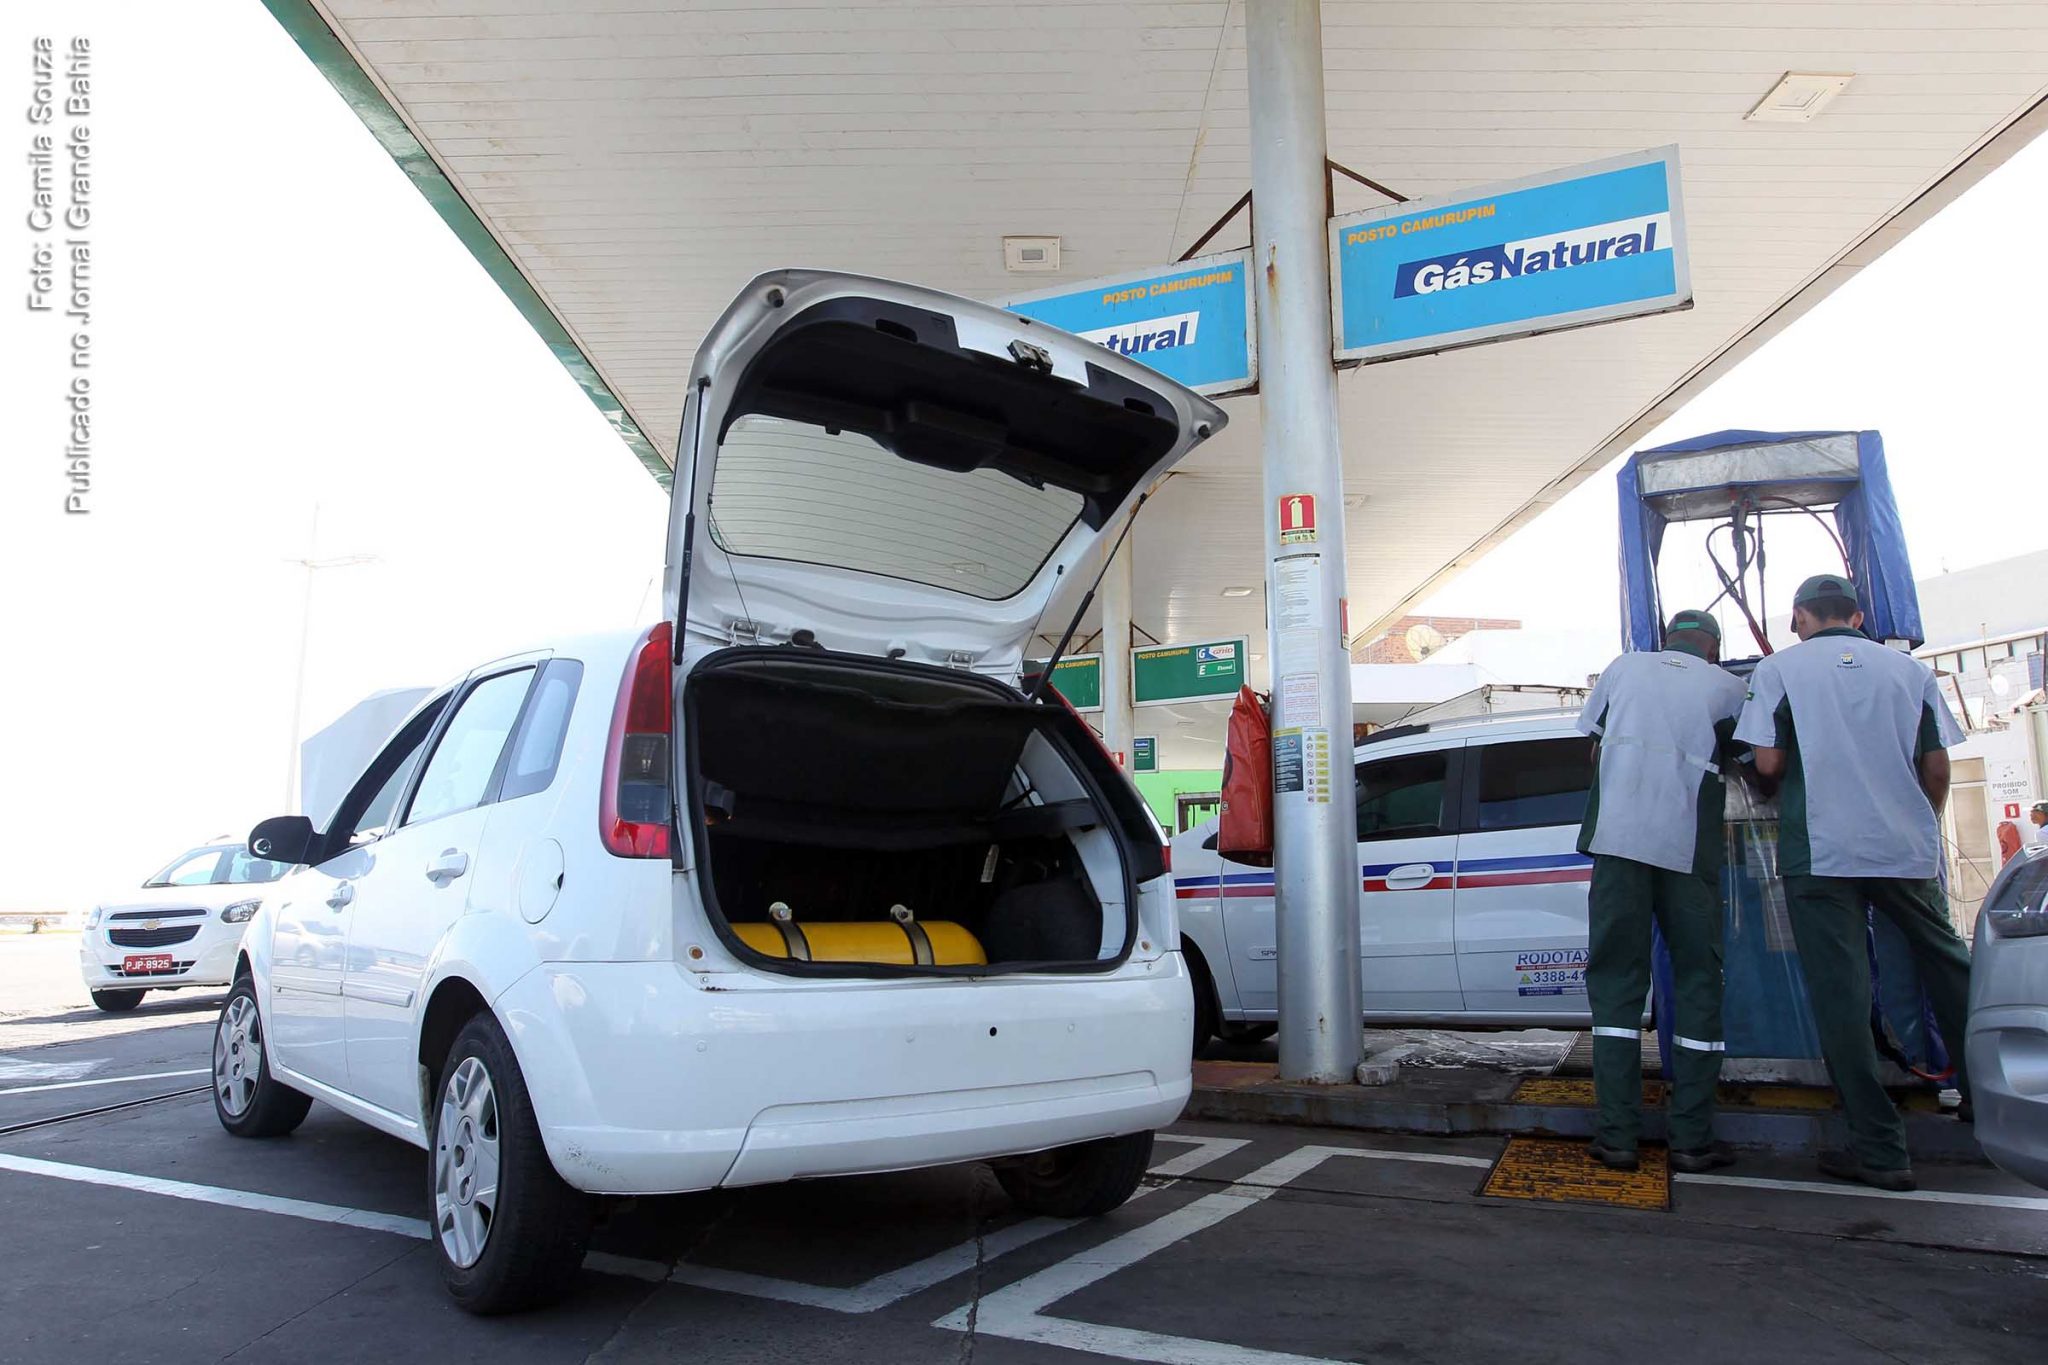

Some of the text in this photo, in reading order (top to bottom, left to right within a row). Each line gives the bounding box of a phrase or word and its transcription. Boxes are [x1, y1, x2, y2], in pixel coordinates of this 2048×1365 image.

[1347, 204, 1496, 246] POSTO CAMURUPIM
[1102, 271, 1233, 305] POSTO CAMURUPIM
[1138, 652, 1156, 660] POSTO
[1199, 648, 1206, 659] G
[1199, 665, 1206, 676] E
